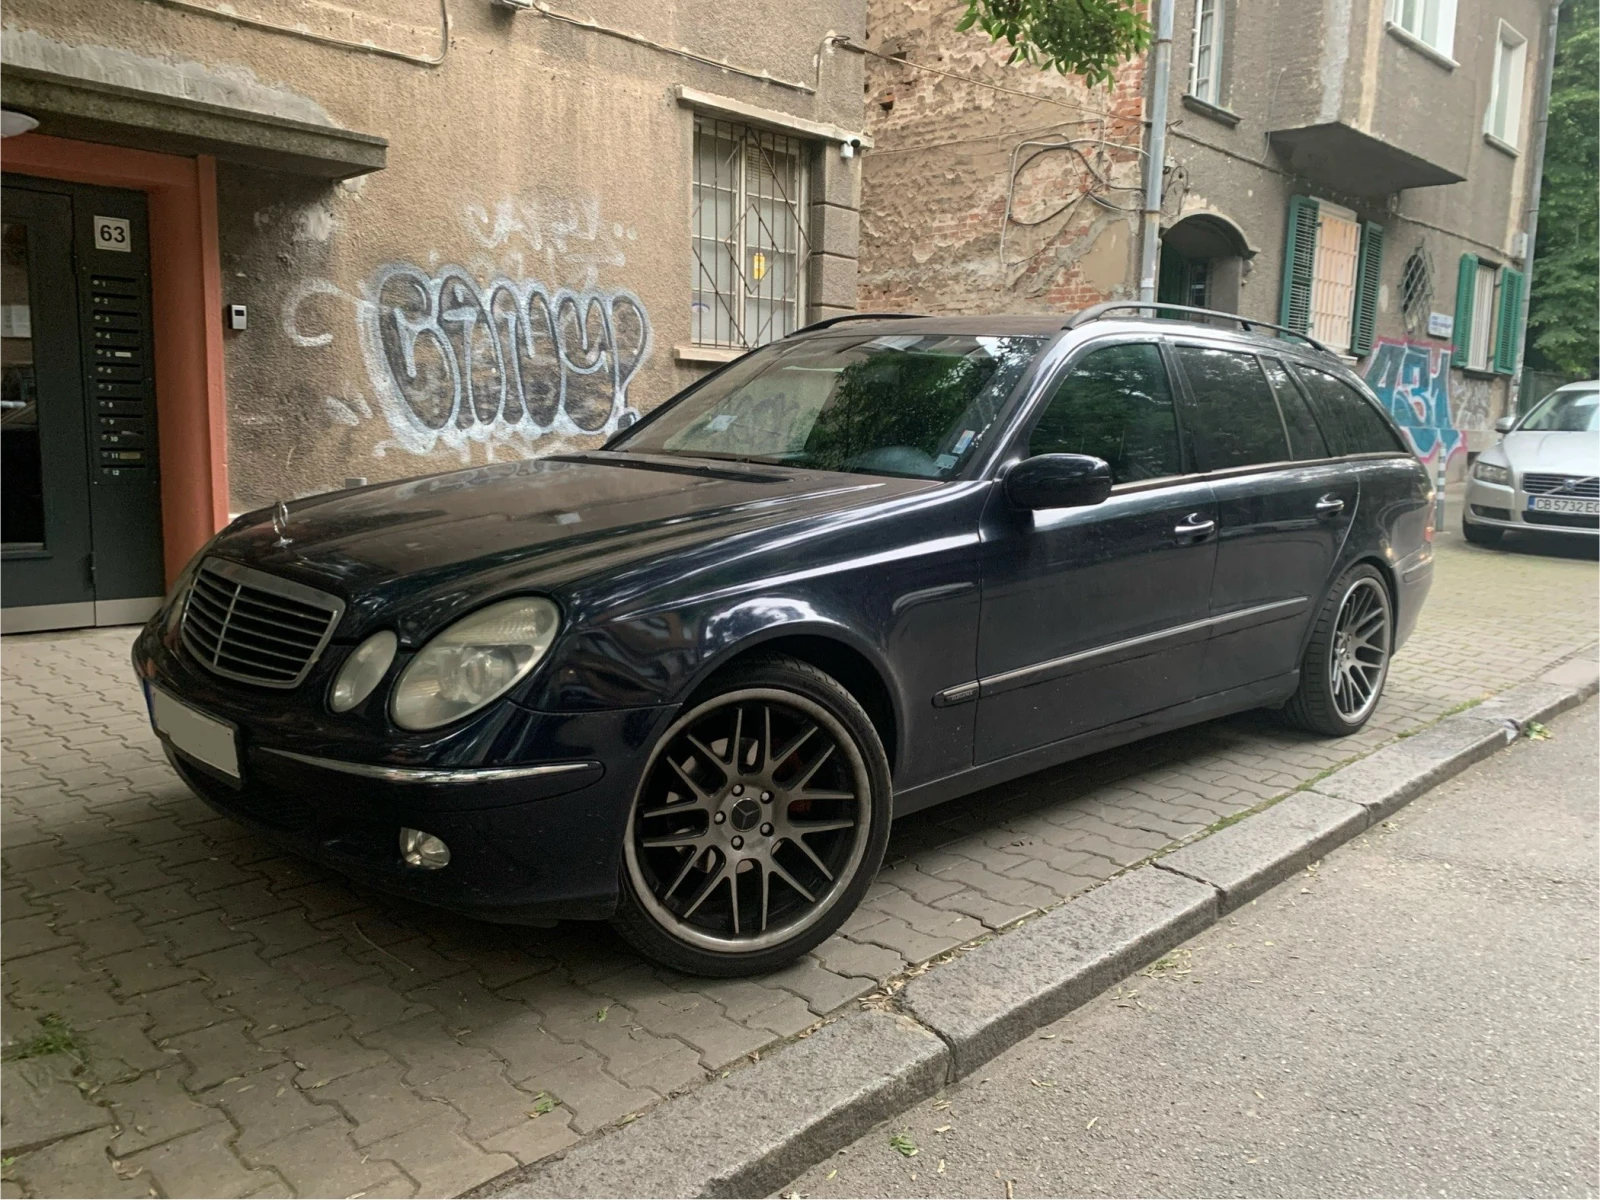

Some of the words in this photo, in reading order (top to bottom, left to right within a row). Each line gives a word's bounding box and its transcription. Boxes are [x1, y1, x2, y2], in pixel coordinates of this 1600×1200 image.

[100, 224, 126, 243] 63
[1536, 499, 1552, 510] CB
[1554, 501, 1584, 512] 5732
